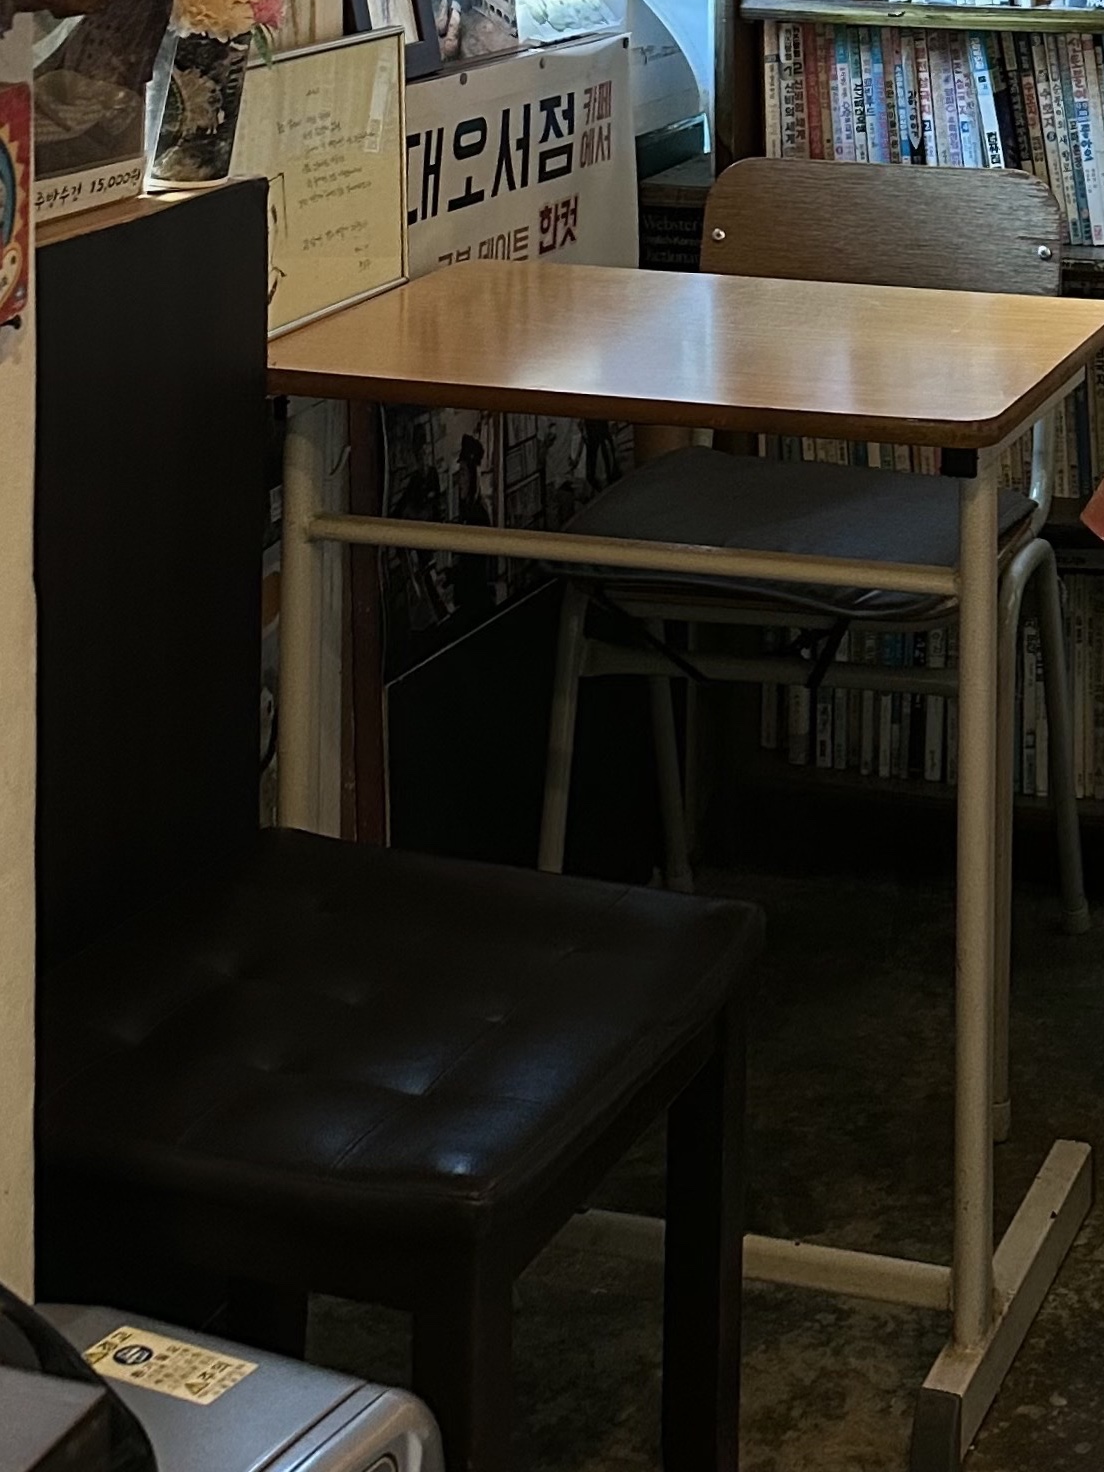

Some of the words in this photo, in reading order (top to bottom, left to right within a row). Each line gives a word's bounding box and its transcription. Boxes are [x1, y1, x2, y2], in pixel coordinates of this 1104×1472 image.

[583, 80, 613, 126] 카페
[407, 91, 576, 227] 대오서점
[579, 123, 612, 169] 에서
[89, 168, 141, 194] 15,000원
[477, 226, 530, 262] 데이트
[538, 196, 579, 255] 한컷
